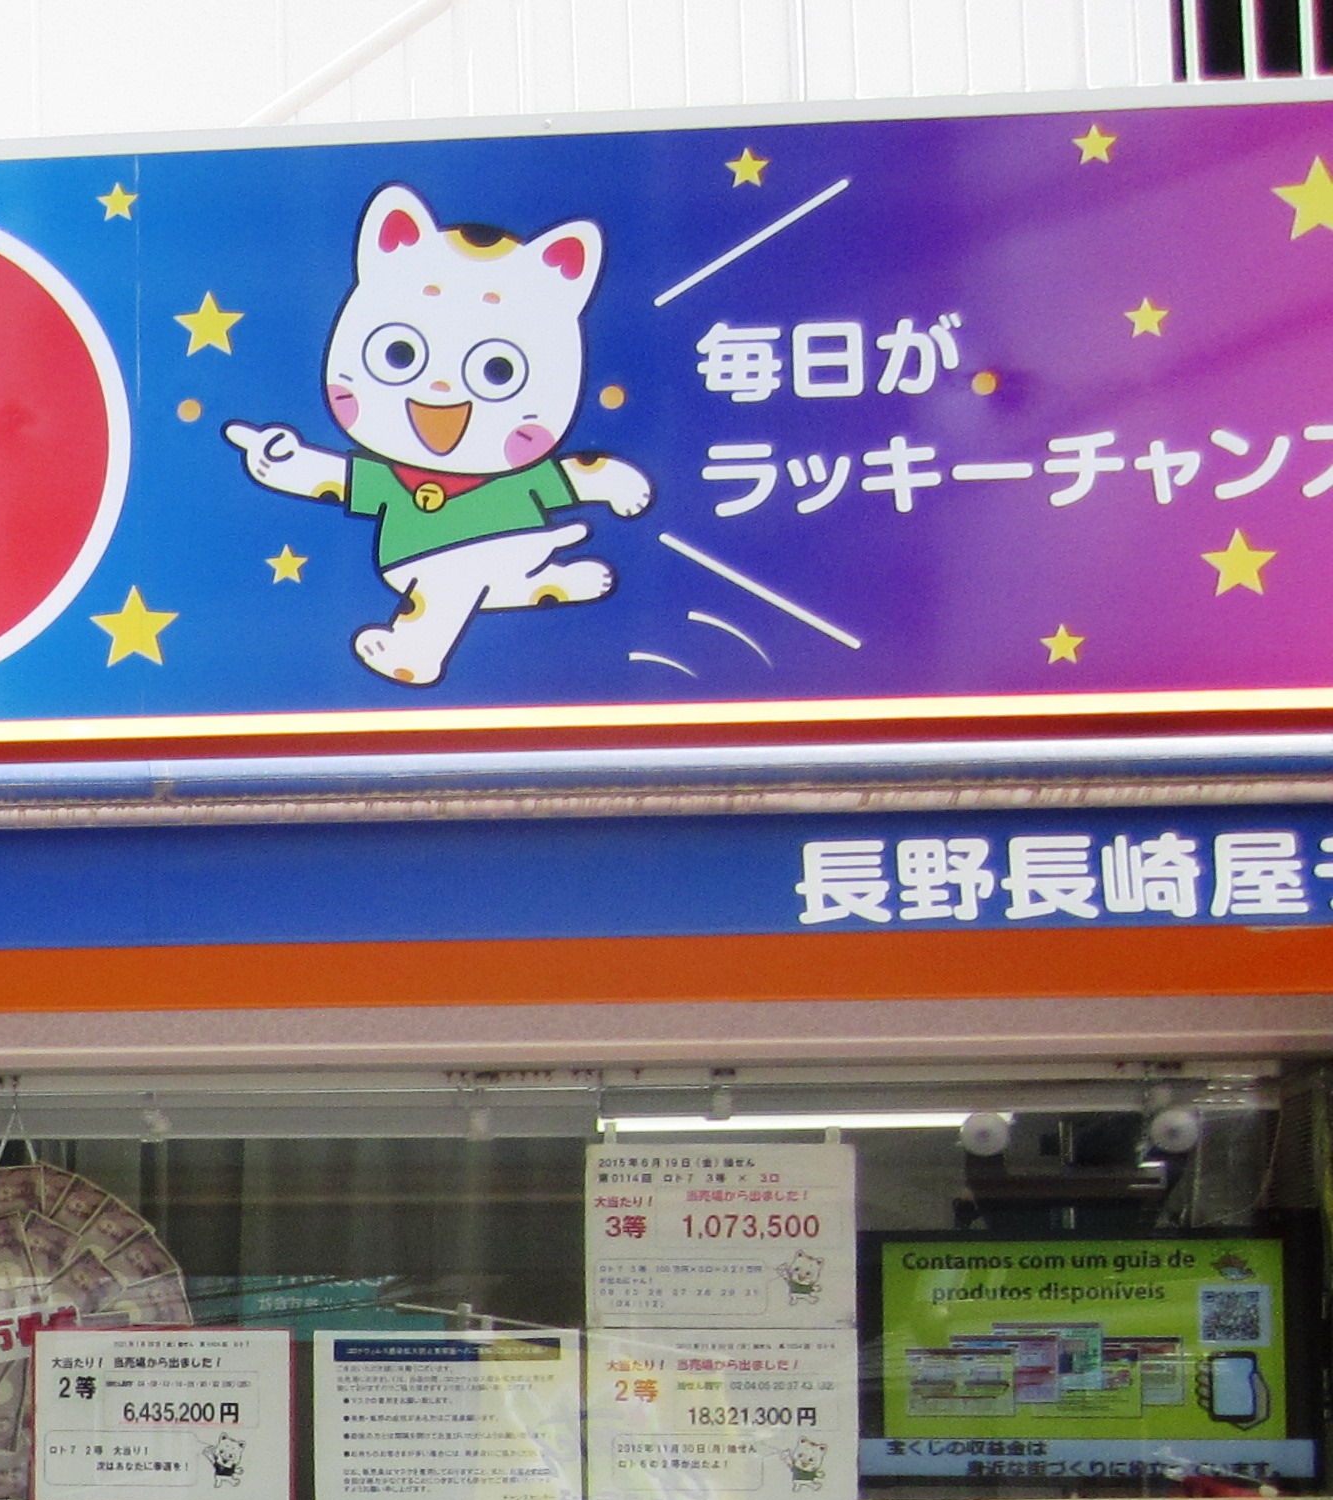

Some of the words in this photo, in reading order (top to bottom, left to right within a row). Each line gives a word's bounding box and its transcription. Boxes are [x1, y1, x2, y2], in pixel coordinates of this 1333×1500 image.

[696, 312, 961, 402] 毎日が
[794, 831, 1333, 925] 長野長崎屋
[594, 1195, 654, 1208] 大当たり！
[605, 1214, 647, 1239] 3等
[682, 1213, 821, 1240] 1,073,500
[902, 1251, 1013, 1271] Contamos
[1018, 1255, 1067, 1270] com
[1071, 1256, 1108, 1270] um
[1112, 1250, 1163, 1275] guia
[1166, 1249, 1196, 1269] de
[932, 1282, 1033, 1306] produtos
[51, 1357, 103, 1369] 大当たり！
[58, 1375, 97, 1400] 2等
[614, 1378, 659, 1403] 2等
